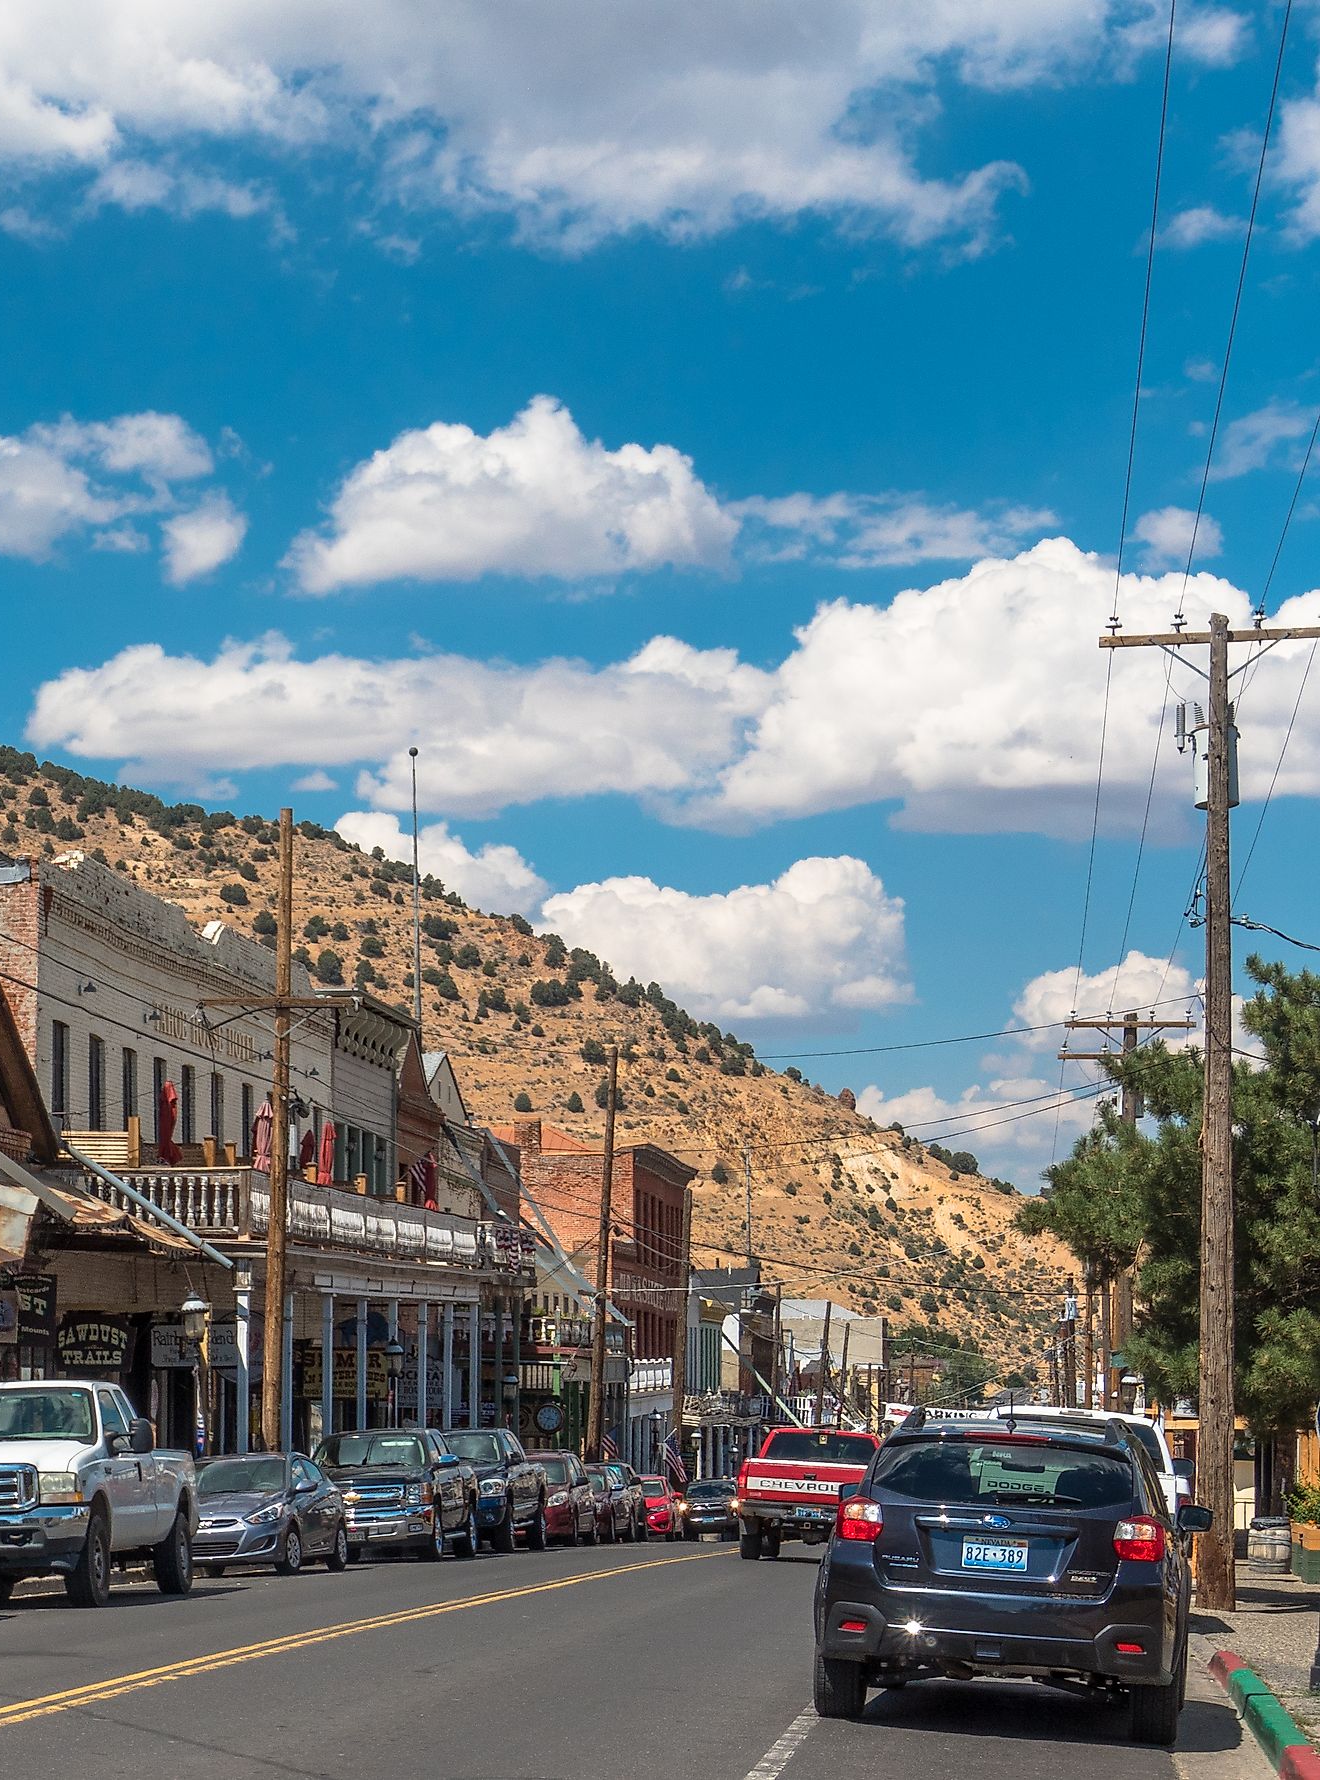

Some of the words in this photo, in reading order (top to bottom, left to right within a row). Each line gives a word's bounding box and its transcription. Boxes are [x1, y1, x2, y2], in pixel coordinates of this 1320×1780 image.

[58, 1323, 128, 1350] SAWDUST
[62, 1350, 122, 1365] TRAILS
[926, 1409, 978, 1419] ARKING
[760, 1480, 839, 1492] CHEVROL
[987, 1480, 1045, 1492] DODGE
